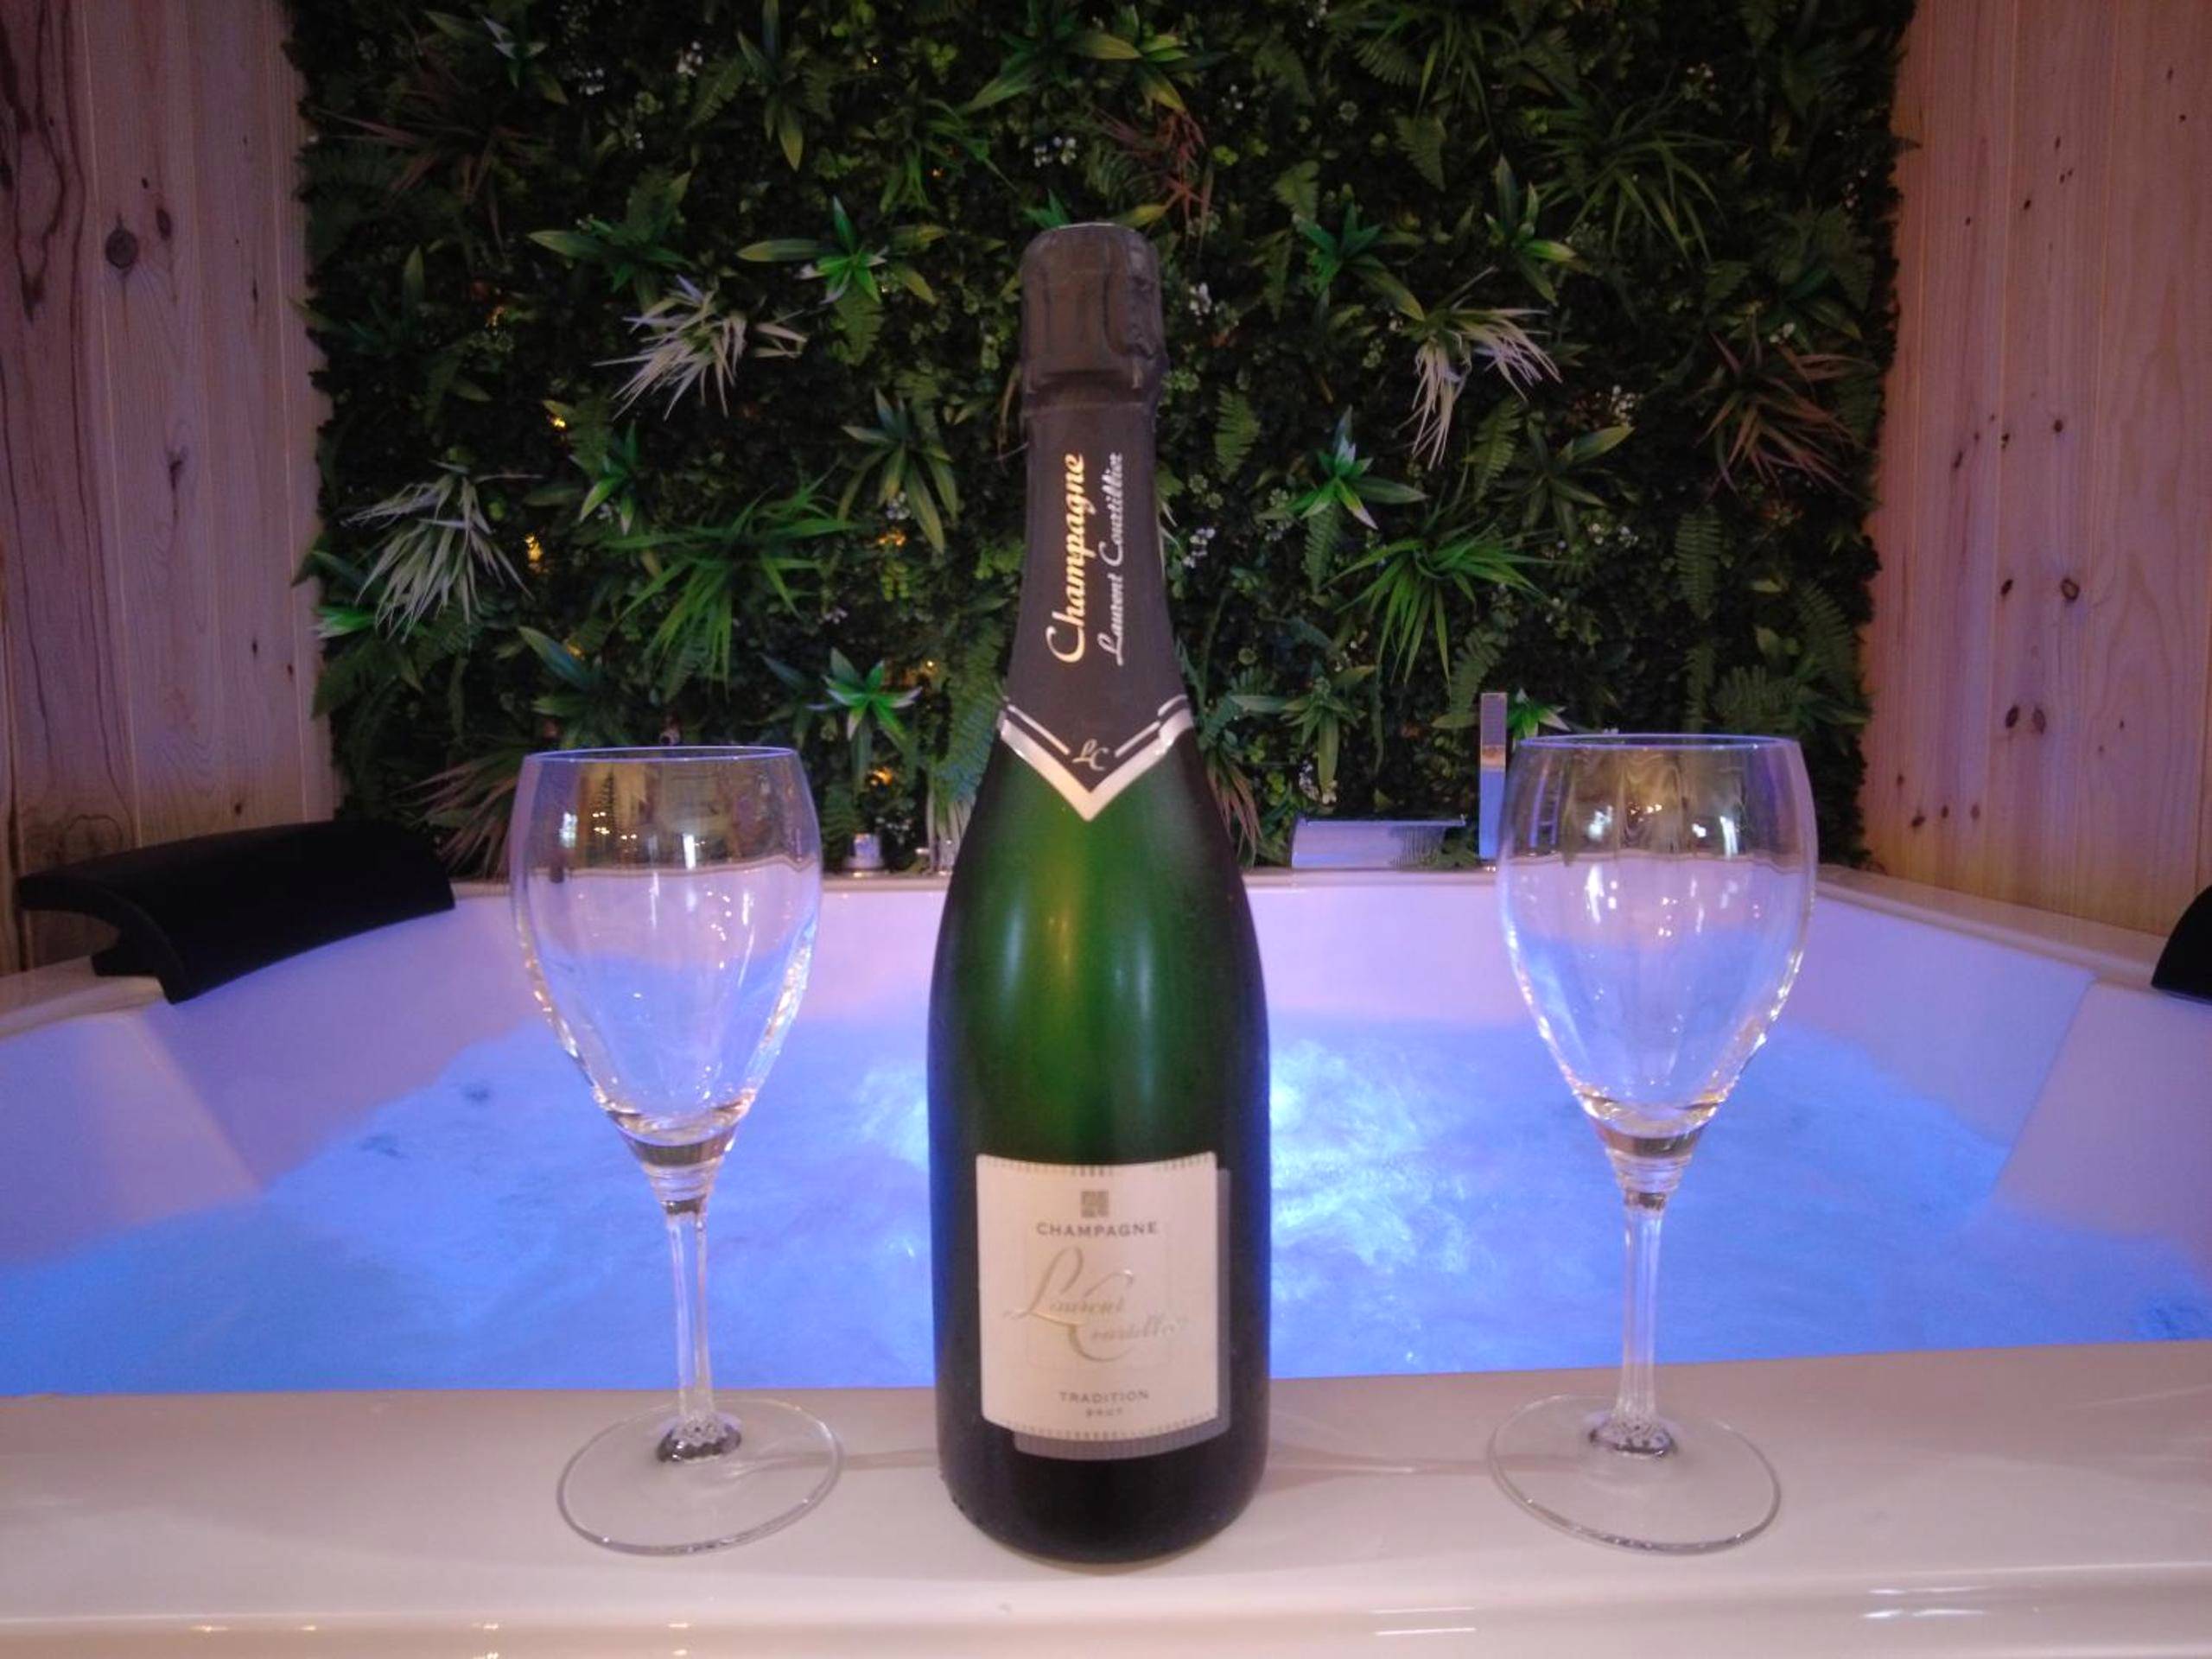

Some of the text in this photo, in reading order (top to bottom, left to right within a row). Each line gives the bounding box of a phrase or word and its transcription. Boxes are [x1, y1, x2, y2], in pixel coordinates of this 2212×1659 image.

[1046, 453, 1096, 663] Champagne
[1097, 574, 1123, 666] Laurent
[1036, 1221, 1157, 1237] CHAMPAGNE
[1058, 1390, 1149, 1404] TRADITION
